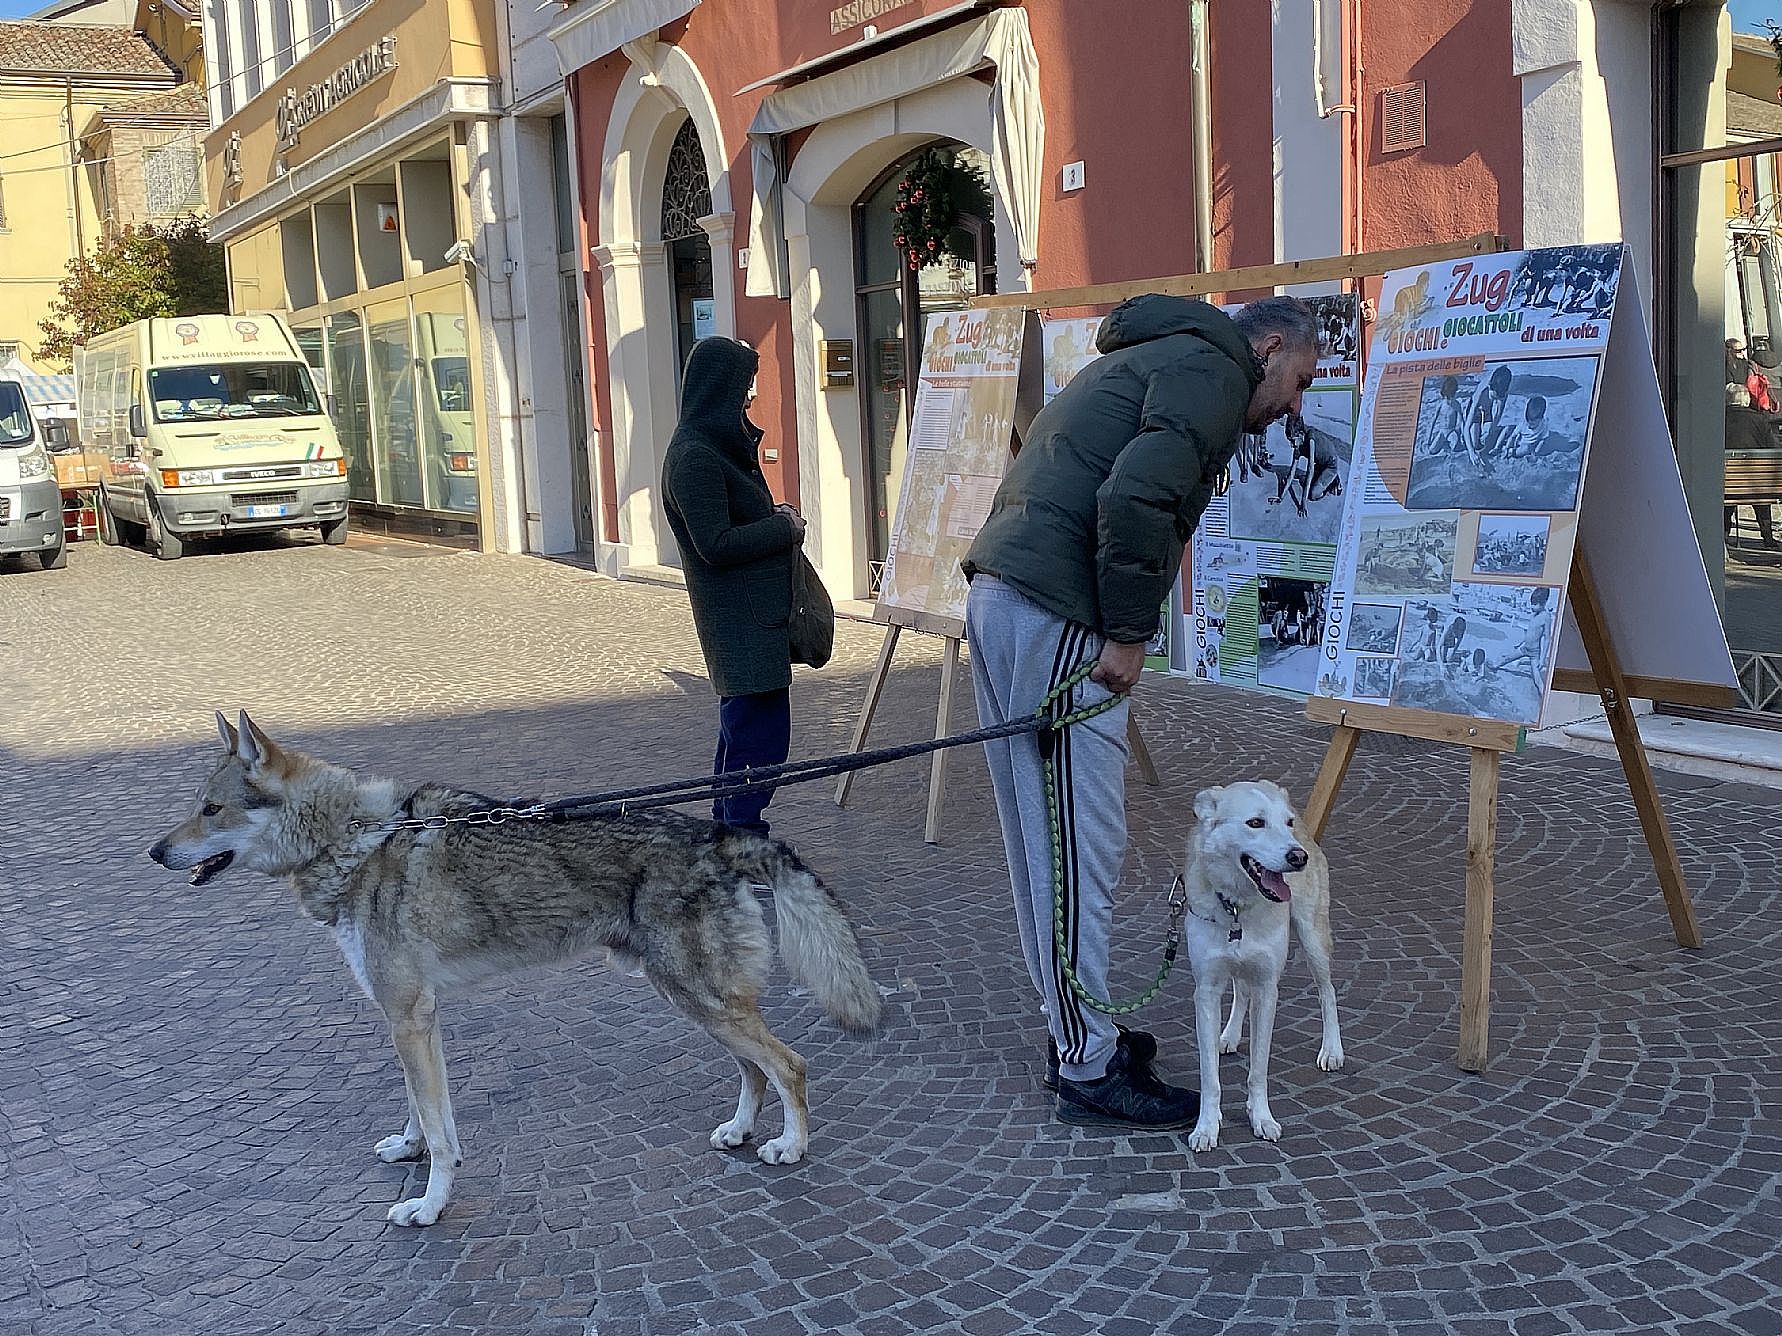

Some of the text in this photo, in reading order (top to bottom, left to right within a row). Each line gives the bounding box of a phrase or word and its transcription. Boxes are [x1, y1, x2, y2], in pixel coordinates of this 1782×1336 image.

[1446, 262, 1511, 312] Zug
[956, 314, 983, 349] Zug
[1388, 312, 1600, 354] GIOCHI e GIOCATTOLI di una volta
[1329, 363, 1351, 377] volta
[1387, 356, 1481, 377] La pista delle biglie
[250, 470, 276, 478] IVECO
[1195, 589, 1207, 649] GIOCHI
[1326, 591, 1345, 660] GIOCHI
